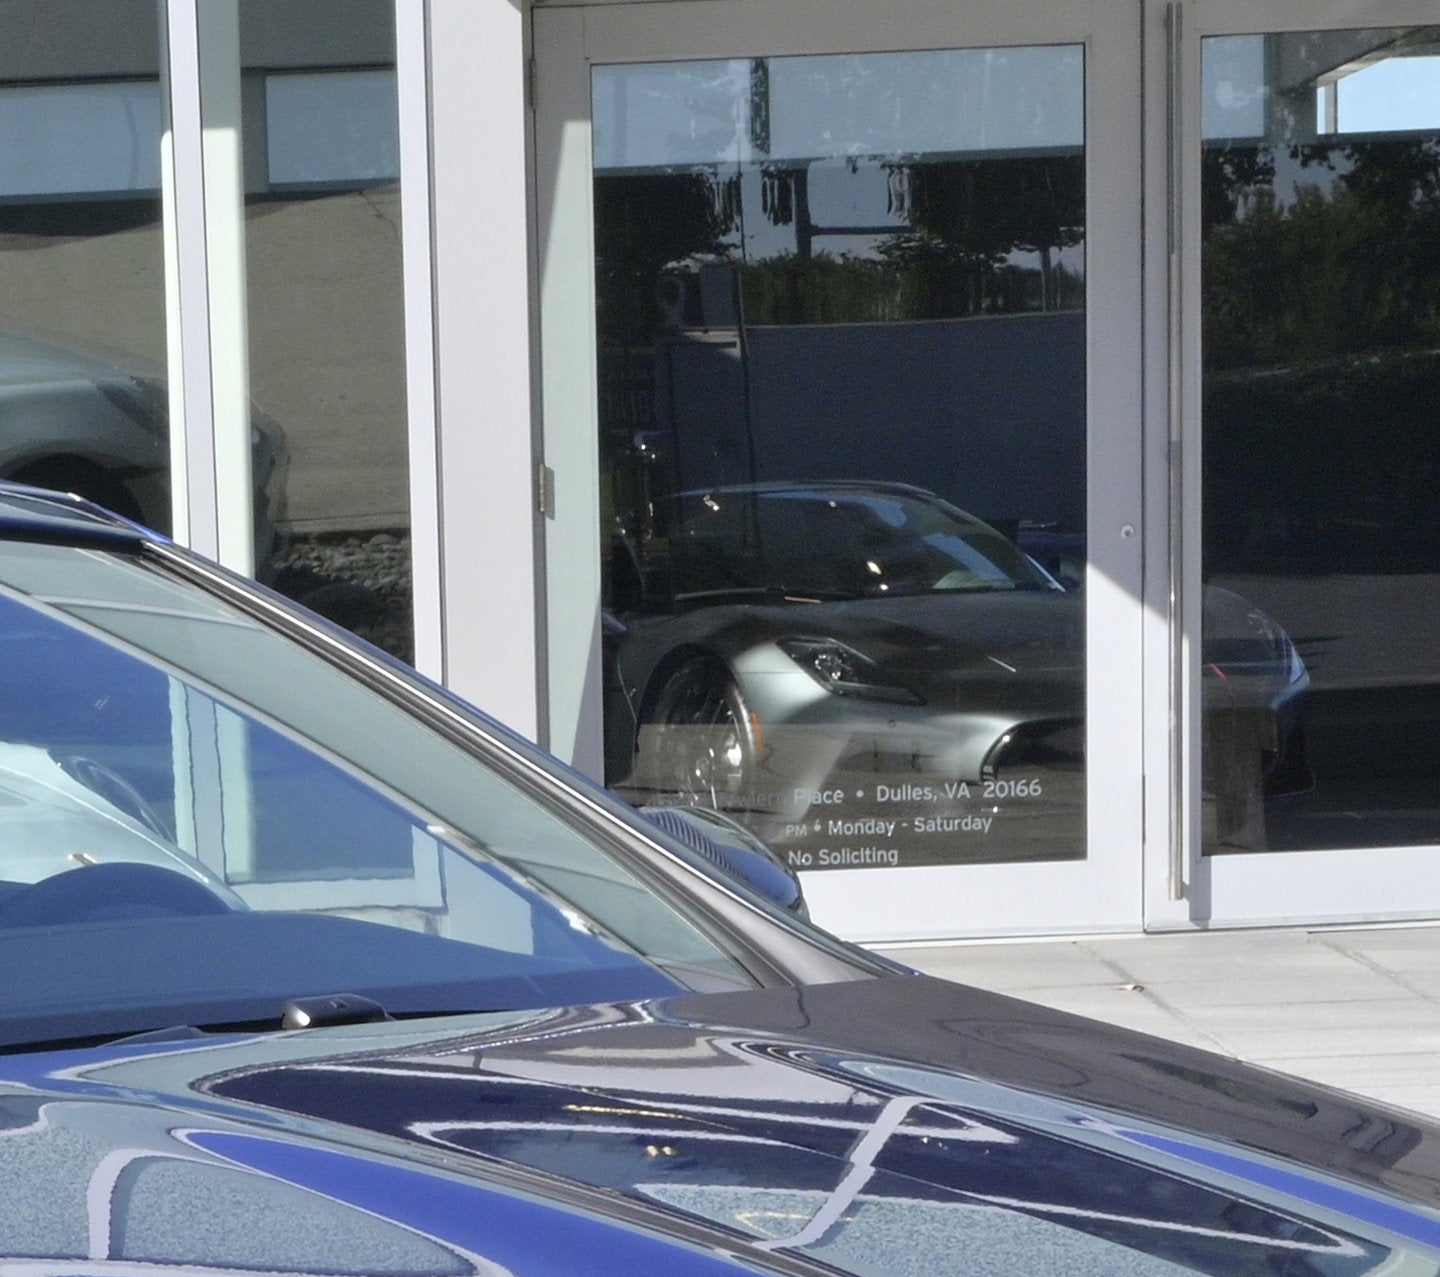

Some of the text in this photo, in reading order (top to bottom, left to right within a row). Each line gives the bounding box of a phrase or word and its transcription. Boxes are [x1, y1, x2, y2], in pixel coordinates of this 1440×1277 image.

[794, 787, 845, 804] Place
[876, 784, 938, 802] Dulles,
[944, 781, 971, 799] VA
[982, 778, 1043, 799] 20166
[785, 823, 808, 837] PM
[828, 818, 896, 838] Monday
[913, 814, 993, 834] Saturday
[788, 846, 899, 866] No Soliciting
